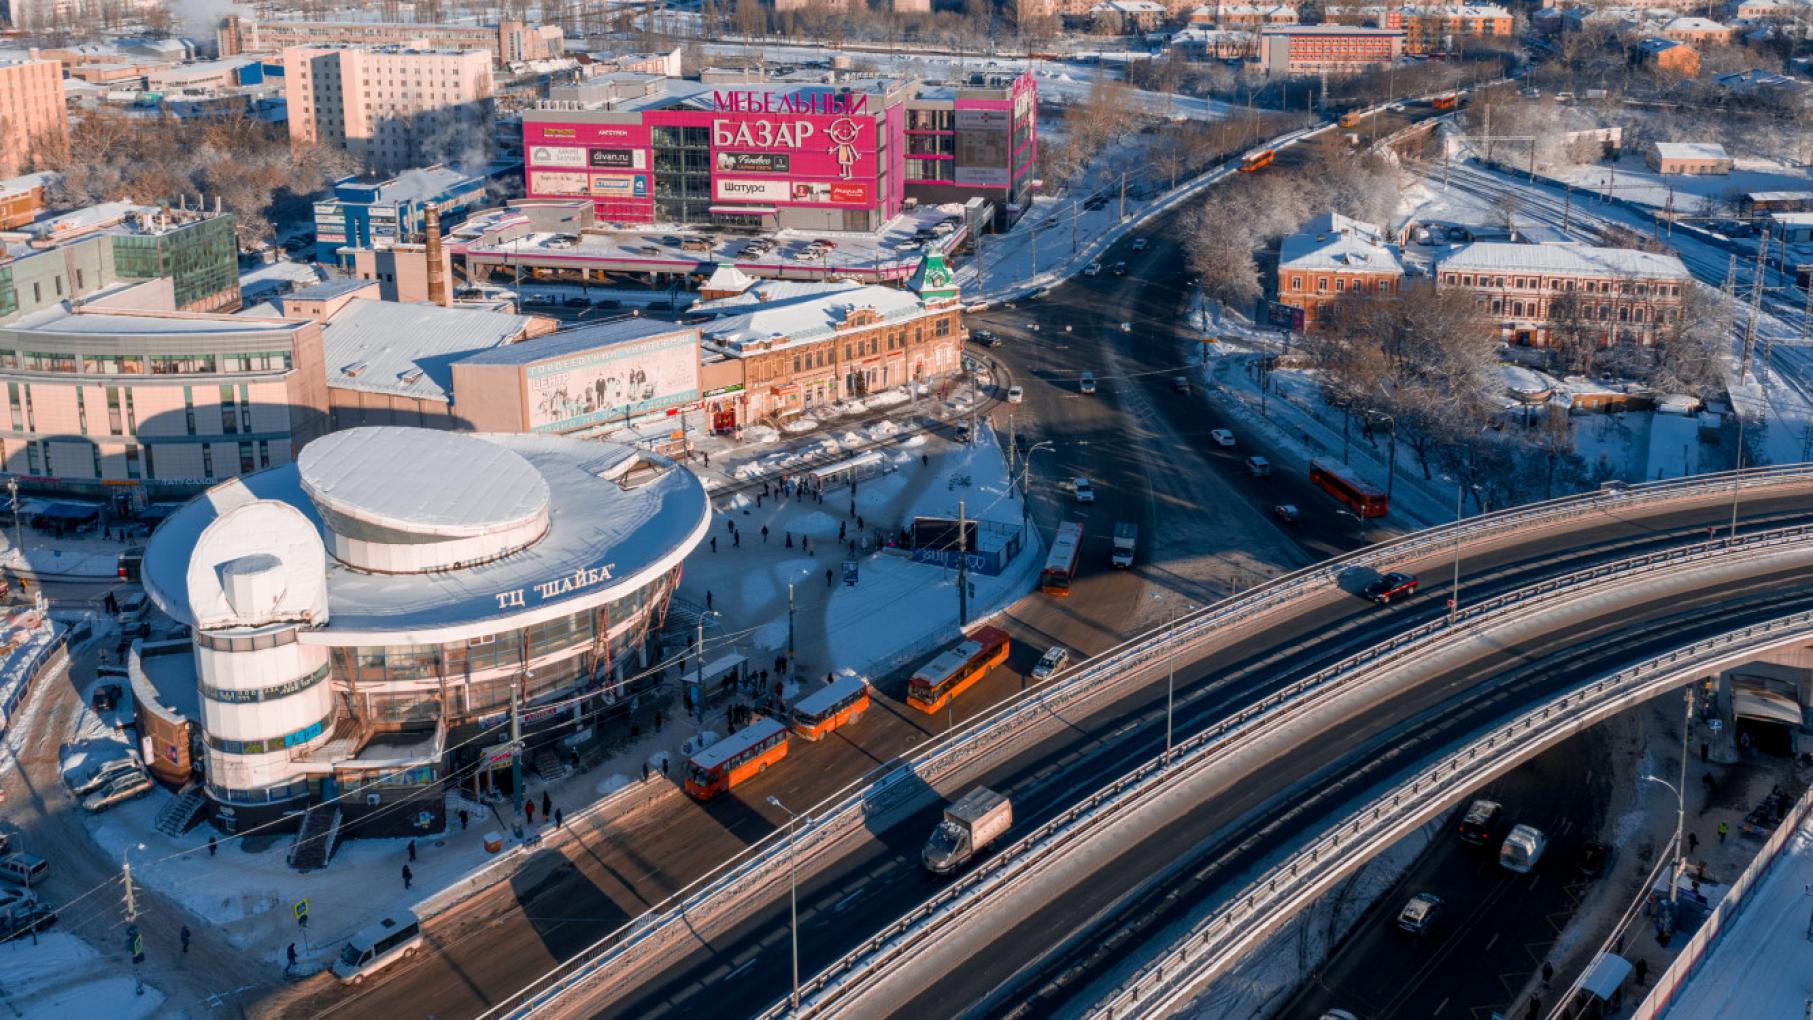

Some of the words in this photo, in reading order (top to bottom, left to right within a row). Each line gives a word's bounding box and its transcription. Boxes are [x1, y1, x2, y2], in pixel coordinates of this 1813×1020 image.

[713, 88, 868, 115] МЕБЕЛЬНЫЙ
[713, 119, 814, 149] БАЗАР
[593, 151, 630, 161] divan.ru
[724, 181, 765, 194] Шатура
[496, 589, 526, 608] ТЦ
[533, 563, 616, 599] "ШАЙБА"
